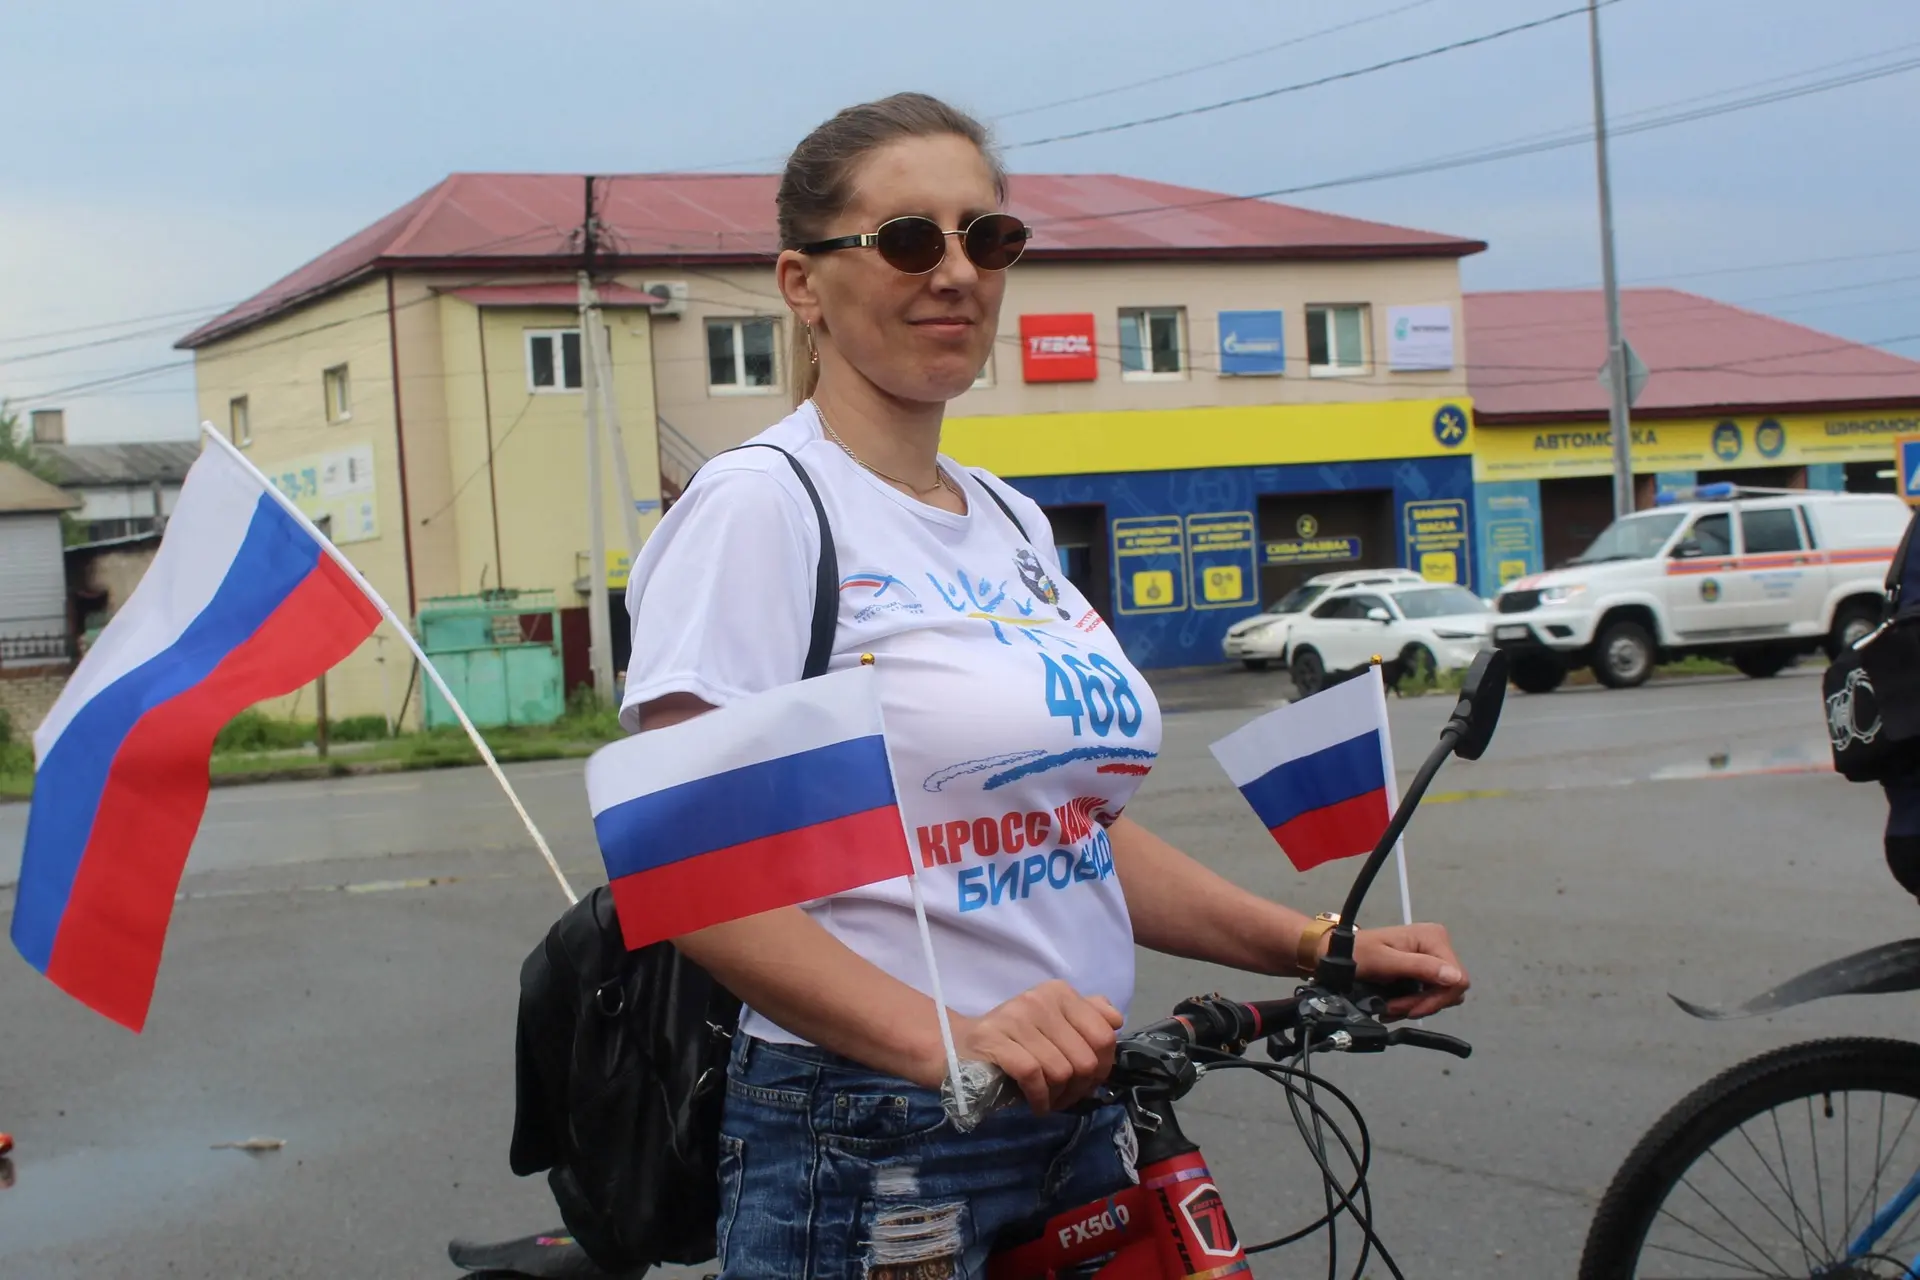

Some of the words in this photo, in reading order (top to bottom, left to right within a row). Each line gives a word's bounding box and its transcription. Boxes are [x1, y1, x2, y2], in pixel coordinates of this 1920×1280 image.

[1533, 429, 1658, 450] АВТОМОКА
[1037, 652, 1142, 738] 468
[916, 811, 1052, 869] КРОСС
[1057, 1203, 1130, 1249] FX500
